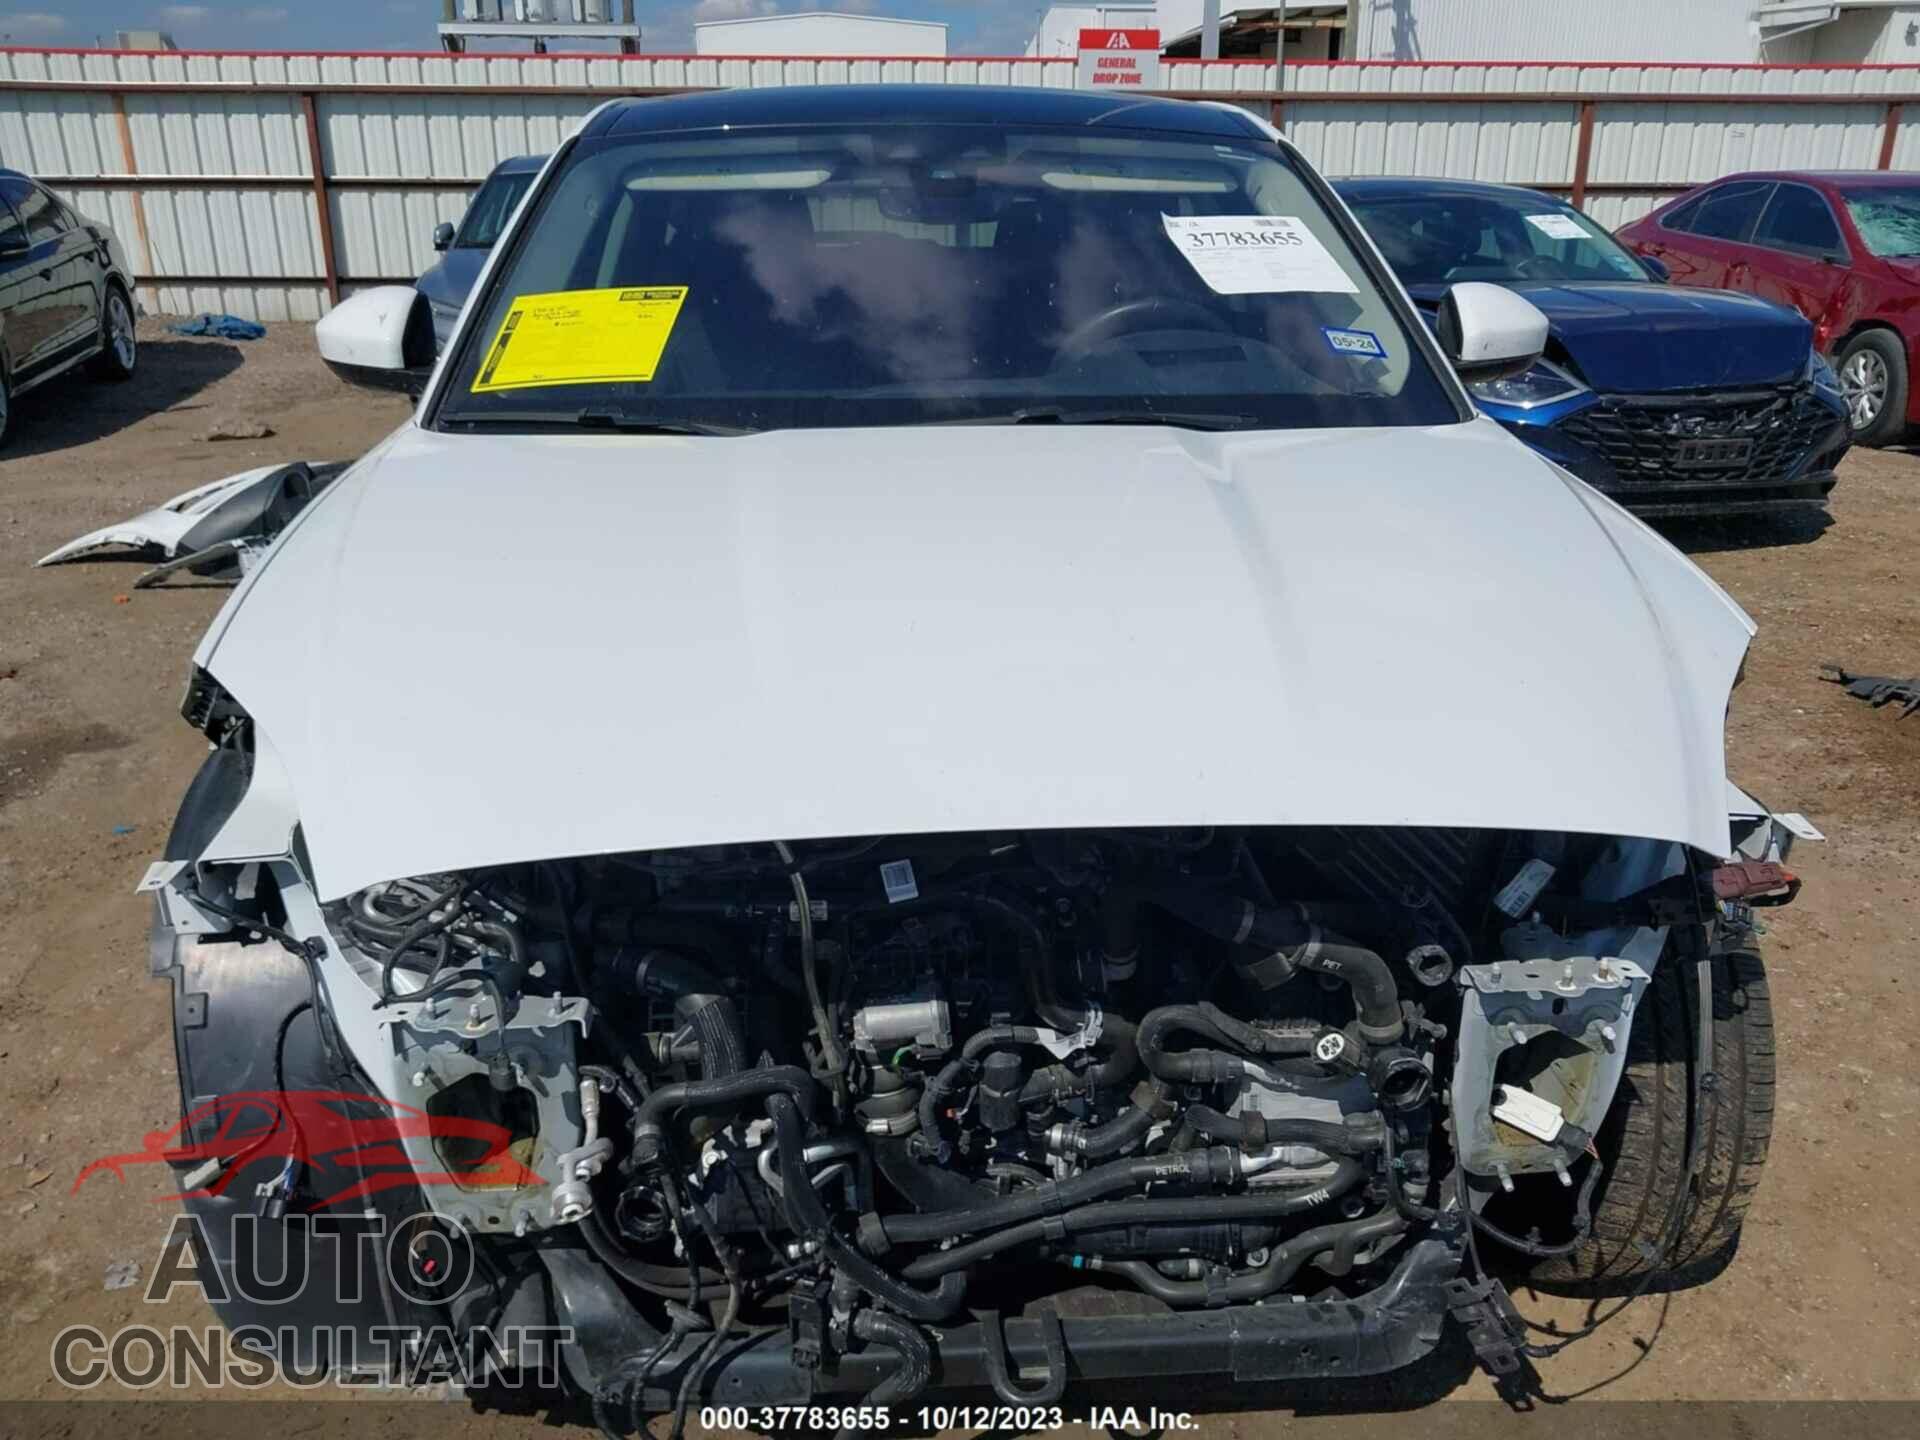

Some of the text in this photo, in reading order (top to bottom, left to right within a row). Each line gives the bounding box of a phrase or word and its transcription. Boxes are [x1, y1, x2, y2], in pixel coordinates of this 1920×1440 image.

[1097, 56, 1136, 69] GENERAL
[1093, 72, 1142, 84] DROP ZONE
[1186, 231, 1303, 247] 37783655
